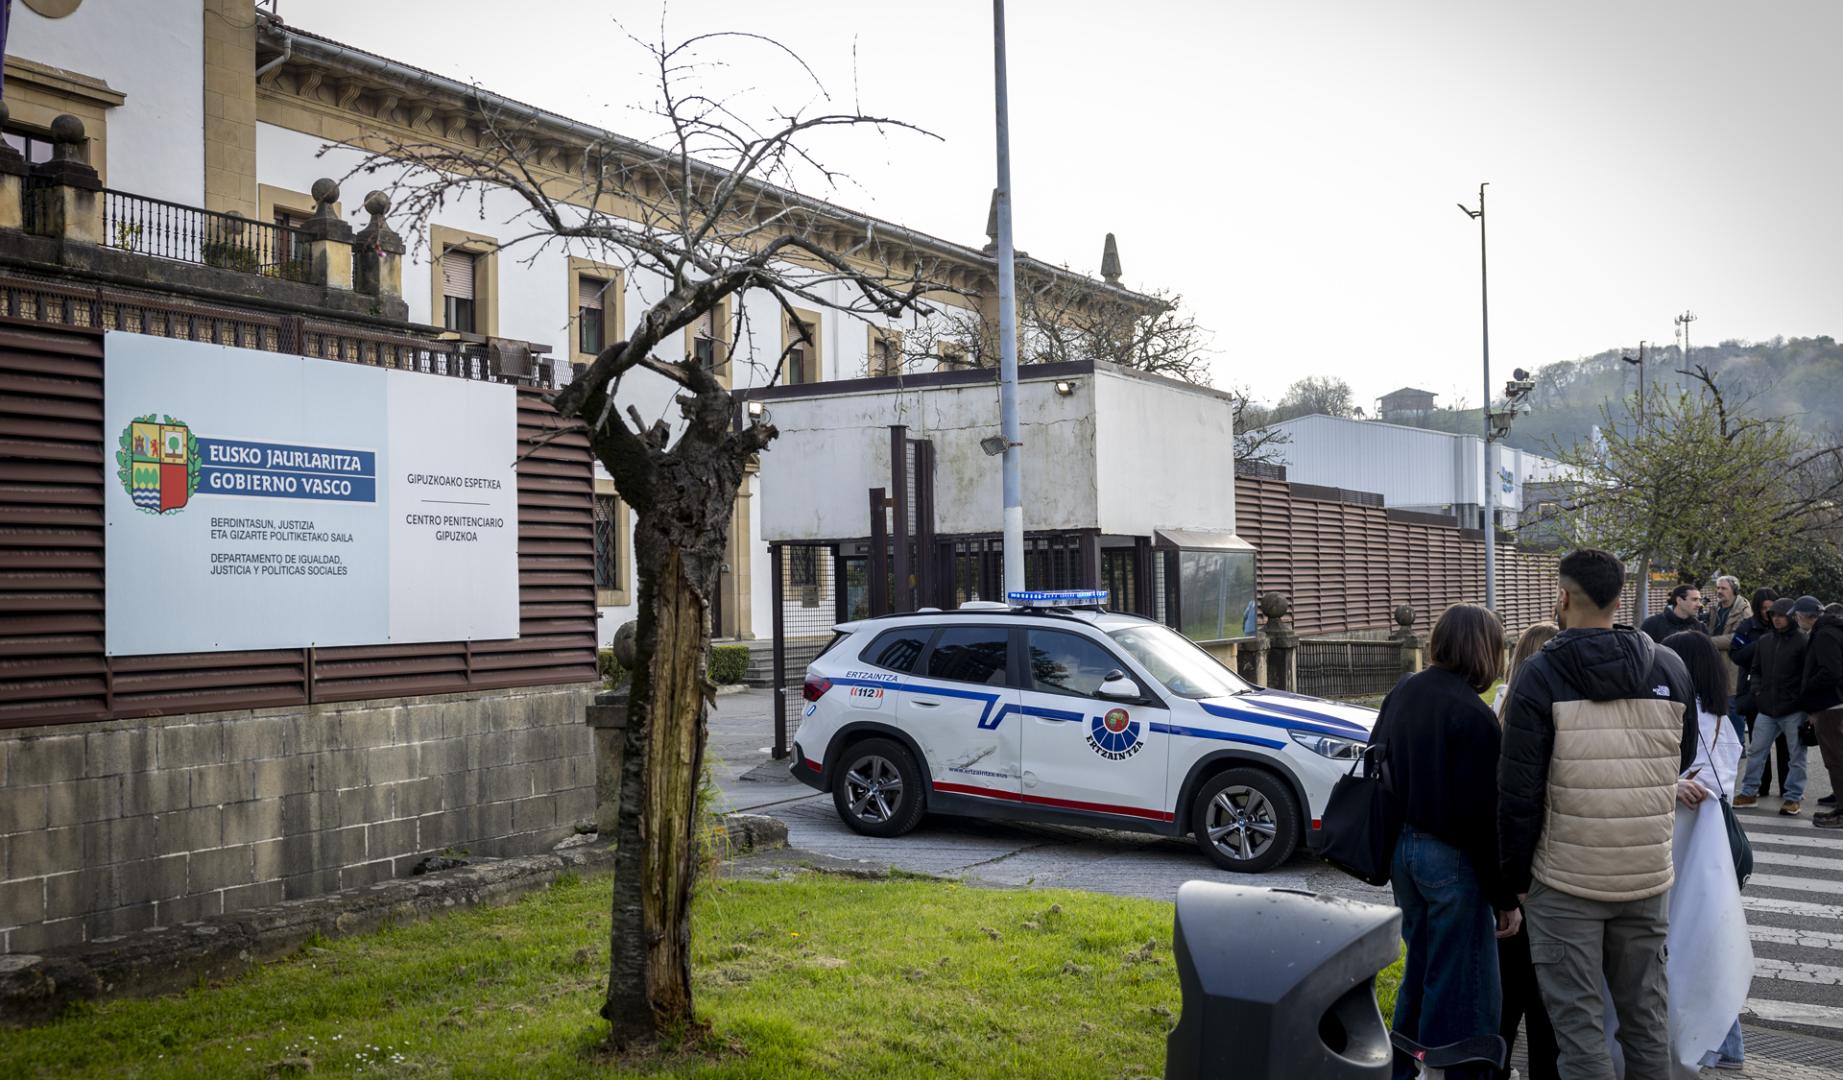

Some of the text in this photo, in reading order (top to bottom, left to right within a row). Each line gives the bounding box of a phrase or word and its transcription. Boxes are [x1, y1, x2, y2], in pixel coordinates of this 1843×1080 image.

[209, 445, 361, 471] EUSKO JAURLARITZA
[209, 472, 351, 496] GOBIERNO VASCO
[407, 473, 502, 490] GIPUZKOAKO ESPETXEA
[210, 517, 315, 531] BERDINTASUN, JUSTIZIA
[406, 514, 504, 528] CENTRO PENITENCIARIO
[210, 529, 354, 543] ETA GIZARTE POLITIKETAKO SAILA
[435, 530, 478, 542] GIPUZKOA
[210, 553, 343, 566] DEPARTAMENTO DE IGUALDAD,
[210, 564, 252, 576] JUSTICIA
[252, 565, 260, 575] Y
[307, 565, 348, 576] SOCIALES
[846, 670, 899, 682] ERTZAINTZA
[1086, 734, 1144, 761] ERTZAINTZA
